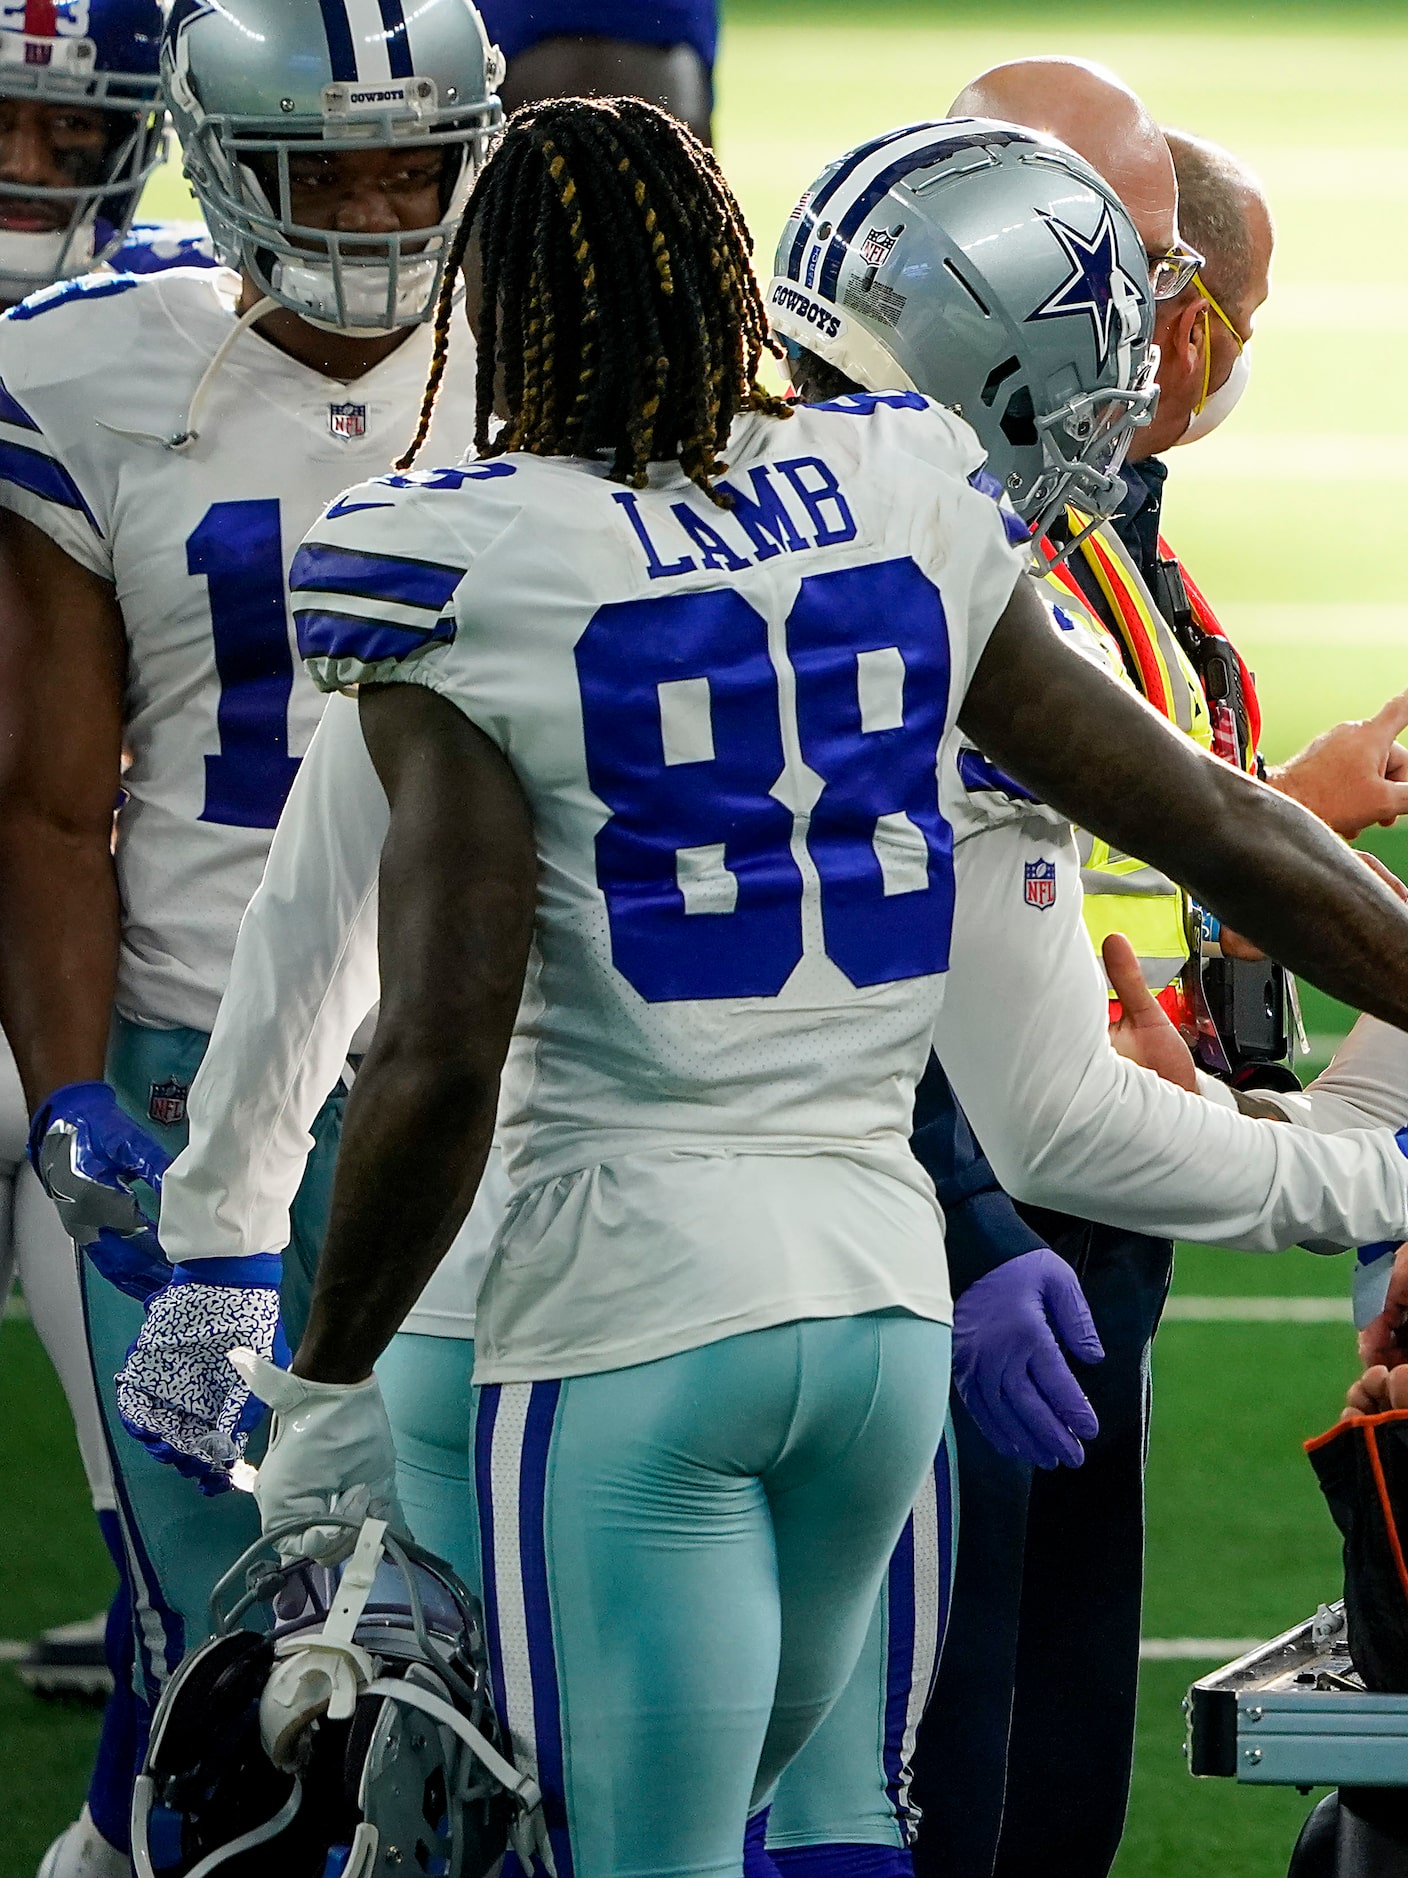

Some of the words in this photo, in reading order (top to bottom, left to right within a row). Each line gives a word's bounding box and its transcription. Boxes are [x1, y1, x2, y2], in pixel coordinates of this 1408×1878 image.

[350, 89, 404, 103] COWBOYS
[863, 240, 887, 264] NFL
[772, 285, 841, 338] COWBOYS
[335, 415, 364, 435] NFL
[613, 455, 858, 580] LAMB
[573, 556, 956, 1004] 88
[1027, 880, 1055, 905] NFL
[153, 1099, 182, 1121] NFL
